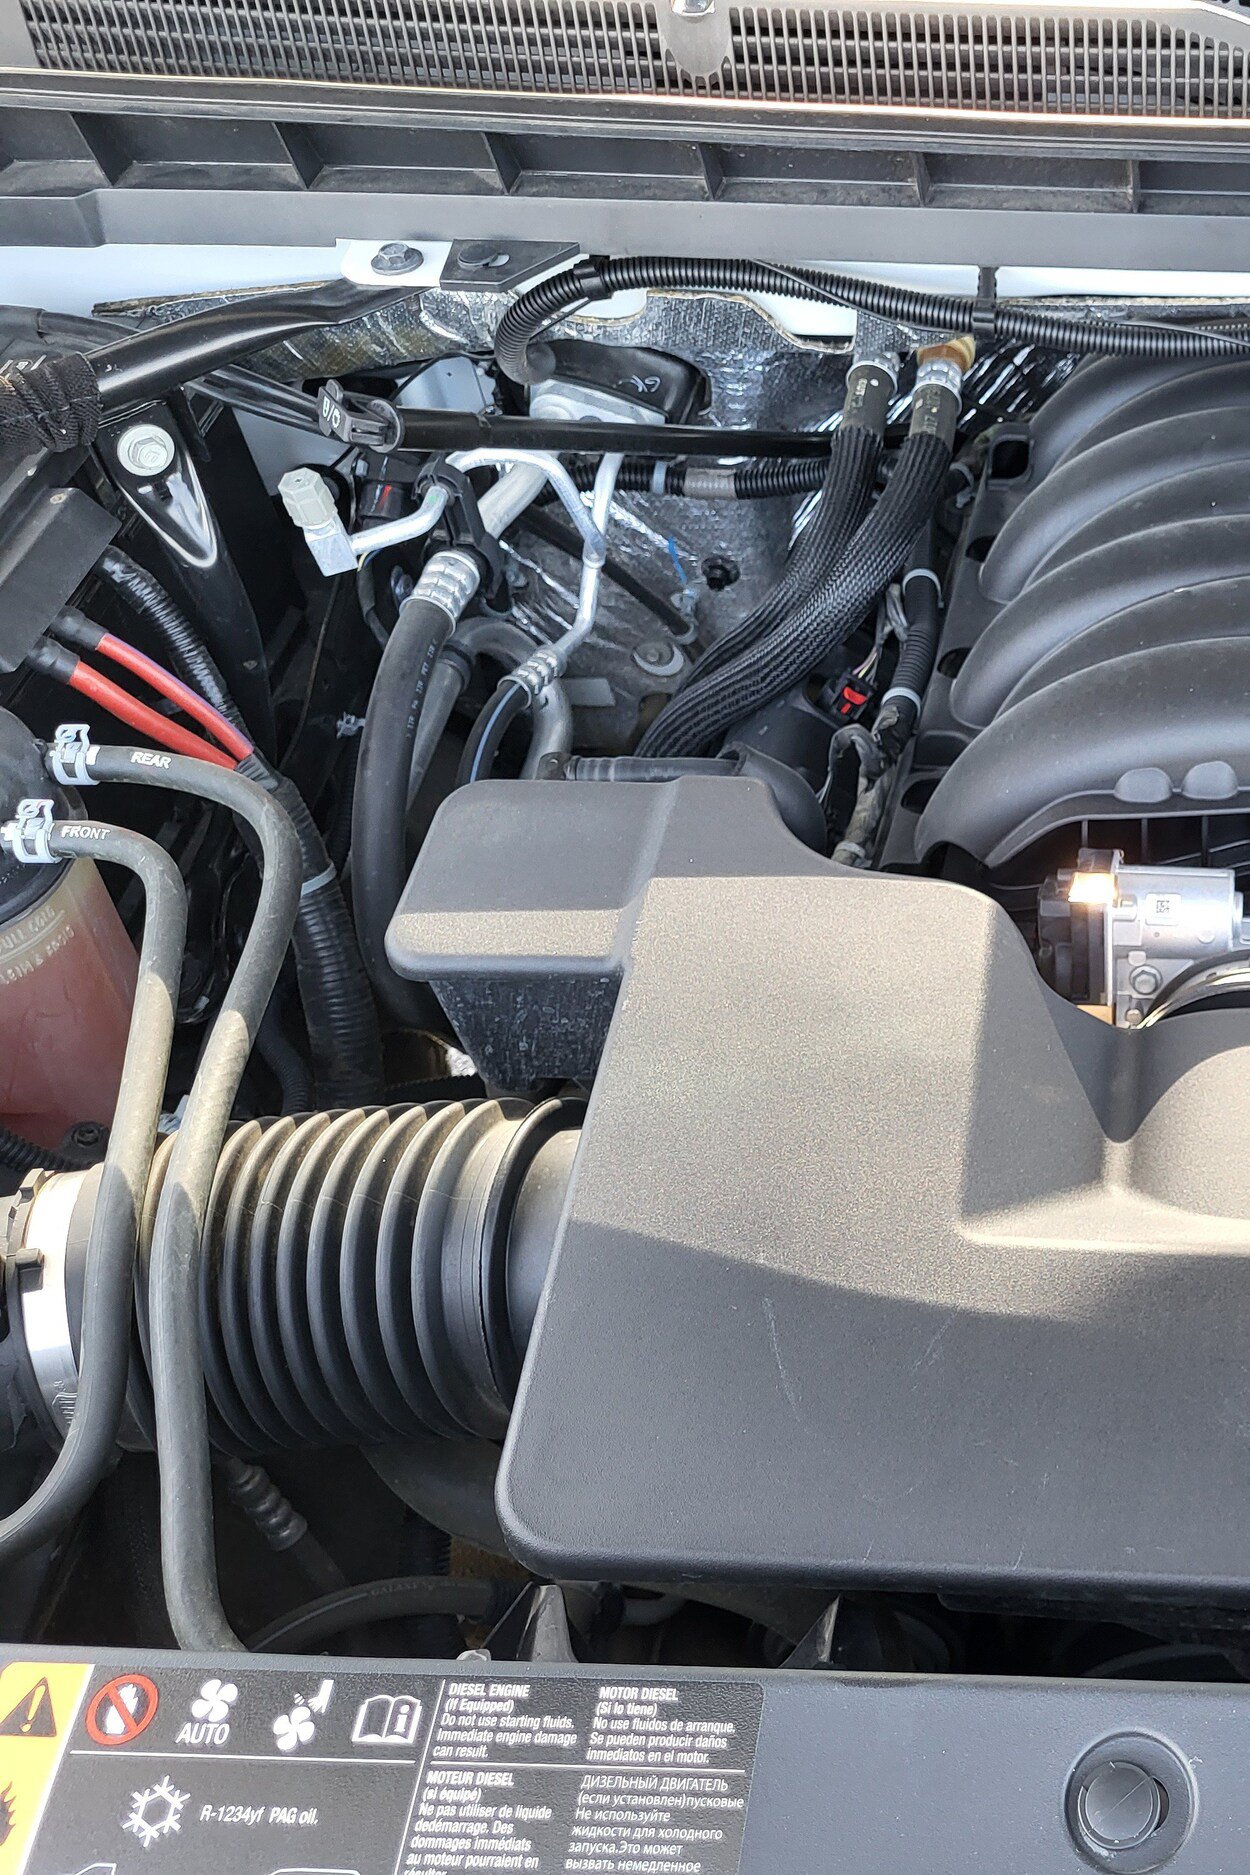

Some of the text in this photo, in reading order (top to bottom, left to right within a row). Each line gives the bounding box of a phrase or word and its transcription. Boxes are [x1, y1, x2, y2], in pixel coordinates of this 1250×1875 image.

[131, 751, 172, 769] REAR
[60, 825, 111, 840] FRONT
[449, 1683, 530, 1697] DIESEL ENGINE
[599, 1687, 679, 1701] MOTOR DIESEL
[459, 1700, 514, 1713] Equipped)
[596, 1702, 657, 1717] (Si lo tiene)
[441, 1713, 575, 1729] Do not use starting fluids.
[593, 1717, 735, 1733] No use fluidos de arranque.
[175, 1722, 230, 1745] AUTO
[496, 1730, 532, 1745] engine
[534, 1732, 577, 1746] damage
[590, 1732, 727, 1748] Se pueden producir daños
[433, 1745, 488, 1757] can result.
[586, 1747, 709, 1763] inmediatos en el motor.
[426, 1770, 515, 1786] MOTEUR DIESEL
[581, 1774, 729, 1792] ДИЗЕЛЬНЫЙ ДВИГАТЕЛЬ
[422, 1786, 482, 1803] (si équipé)
[578, 1791, 612, 1807] (если
[199, 1805, 318, 1825] R-1234yf PAG oil.
[418, 1802, 552, 1820] Ne pas utiliser de liquide
[576, 1807, 671, 1824] Не используйте
[414, 1818, 514, 1836] dedémarrage. Des
[571, 1826, 723, 1841] жидкости для холодного
[410, 1834, 532, 1852] dommages immédiats
[643, 1844, 683, 1855] может
[406, 1852, 539, 1869] au moteur pourraient en
[565, 1858, 701, 1873] вызвать немедленное
